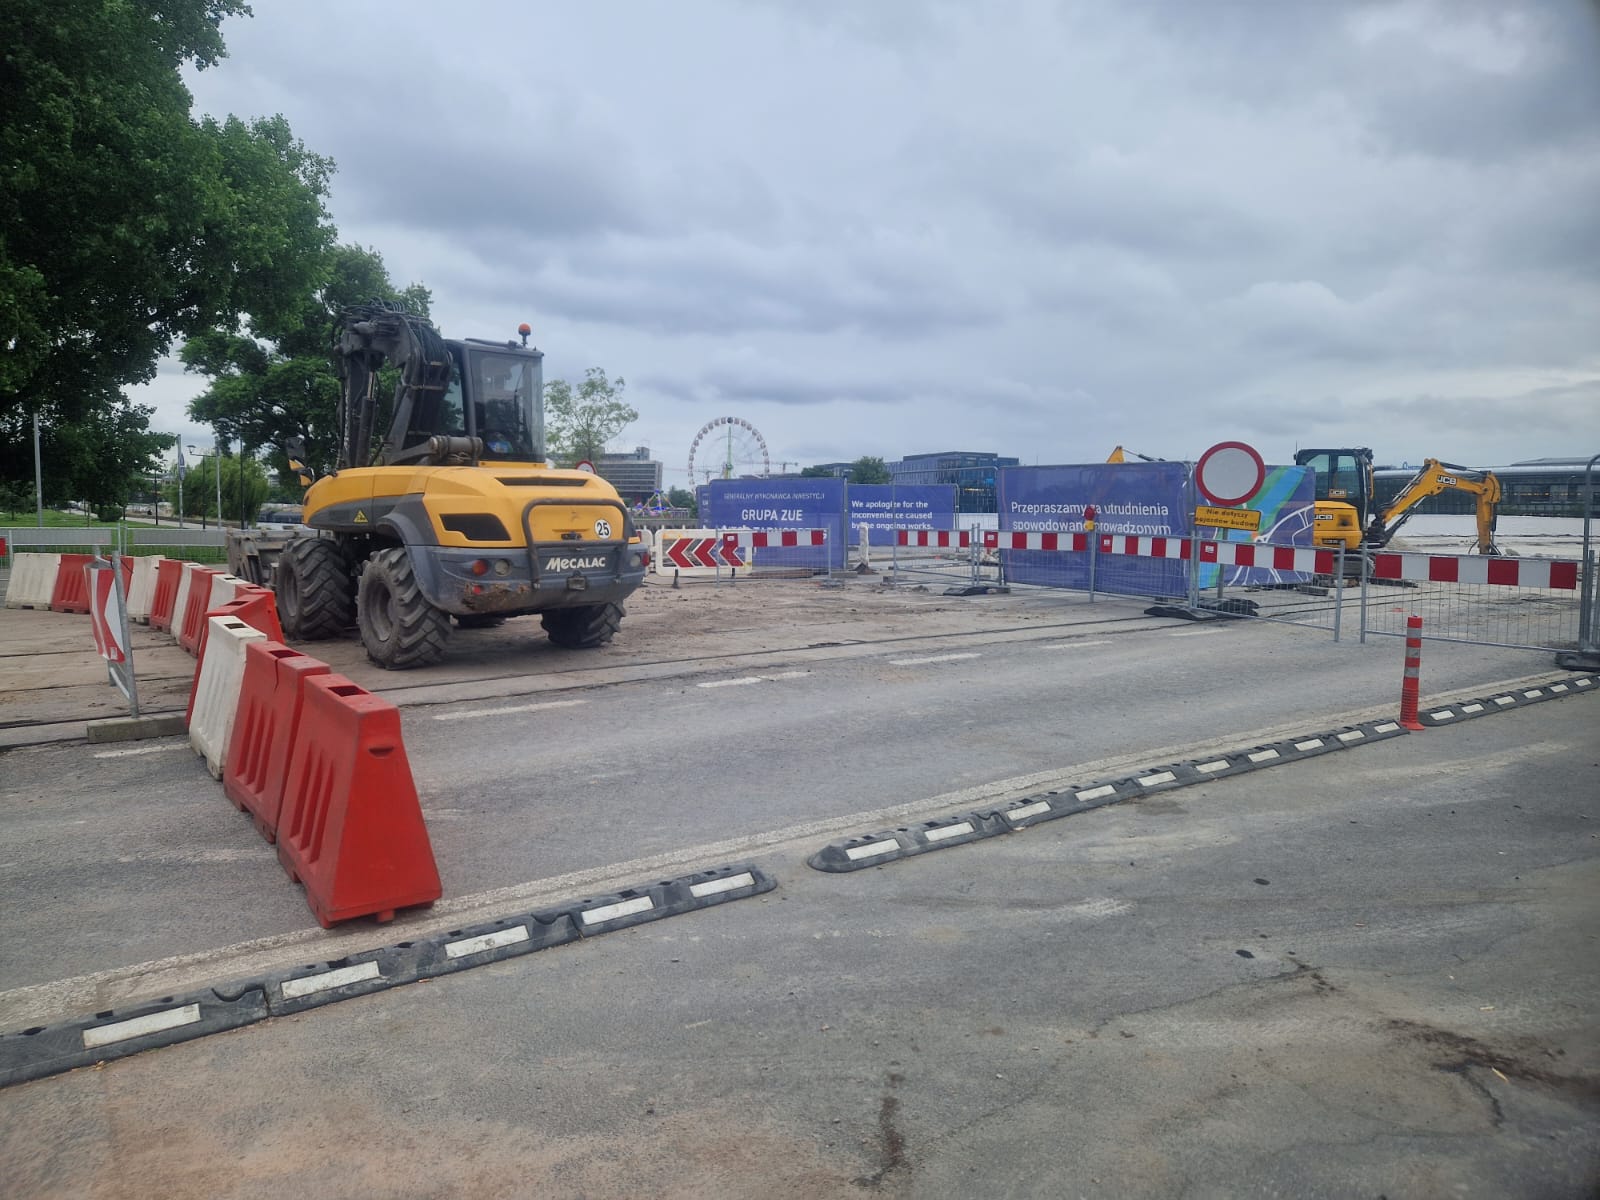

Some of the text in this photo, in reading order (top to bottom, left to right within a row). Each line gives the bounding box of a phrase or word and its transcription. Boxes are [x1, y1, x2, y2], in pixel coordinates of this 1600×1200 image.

[1437, 475, 1457, 486] JCB
[851, 500, 864, 508] We
[903, 500, 914, 508] for
[916, 500, 928, 508] the
[1011, 501, 1088, 516] Przepraszamy
[1104, 502, 1169, 516] utrudnienia
[742, 509, 804, 521] GRUPA ZUE
[906, 511, 933, 519] caused
[597, 522, 610, 536] 25
